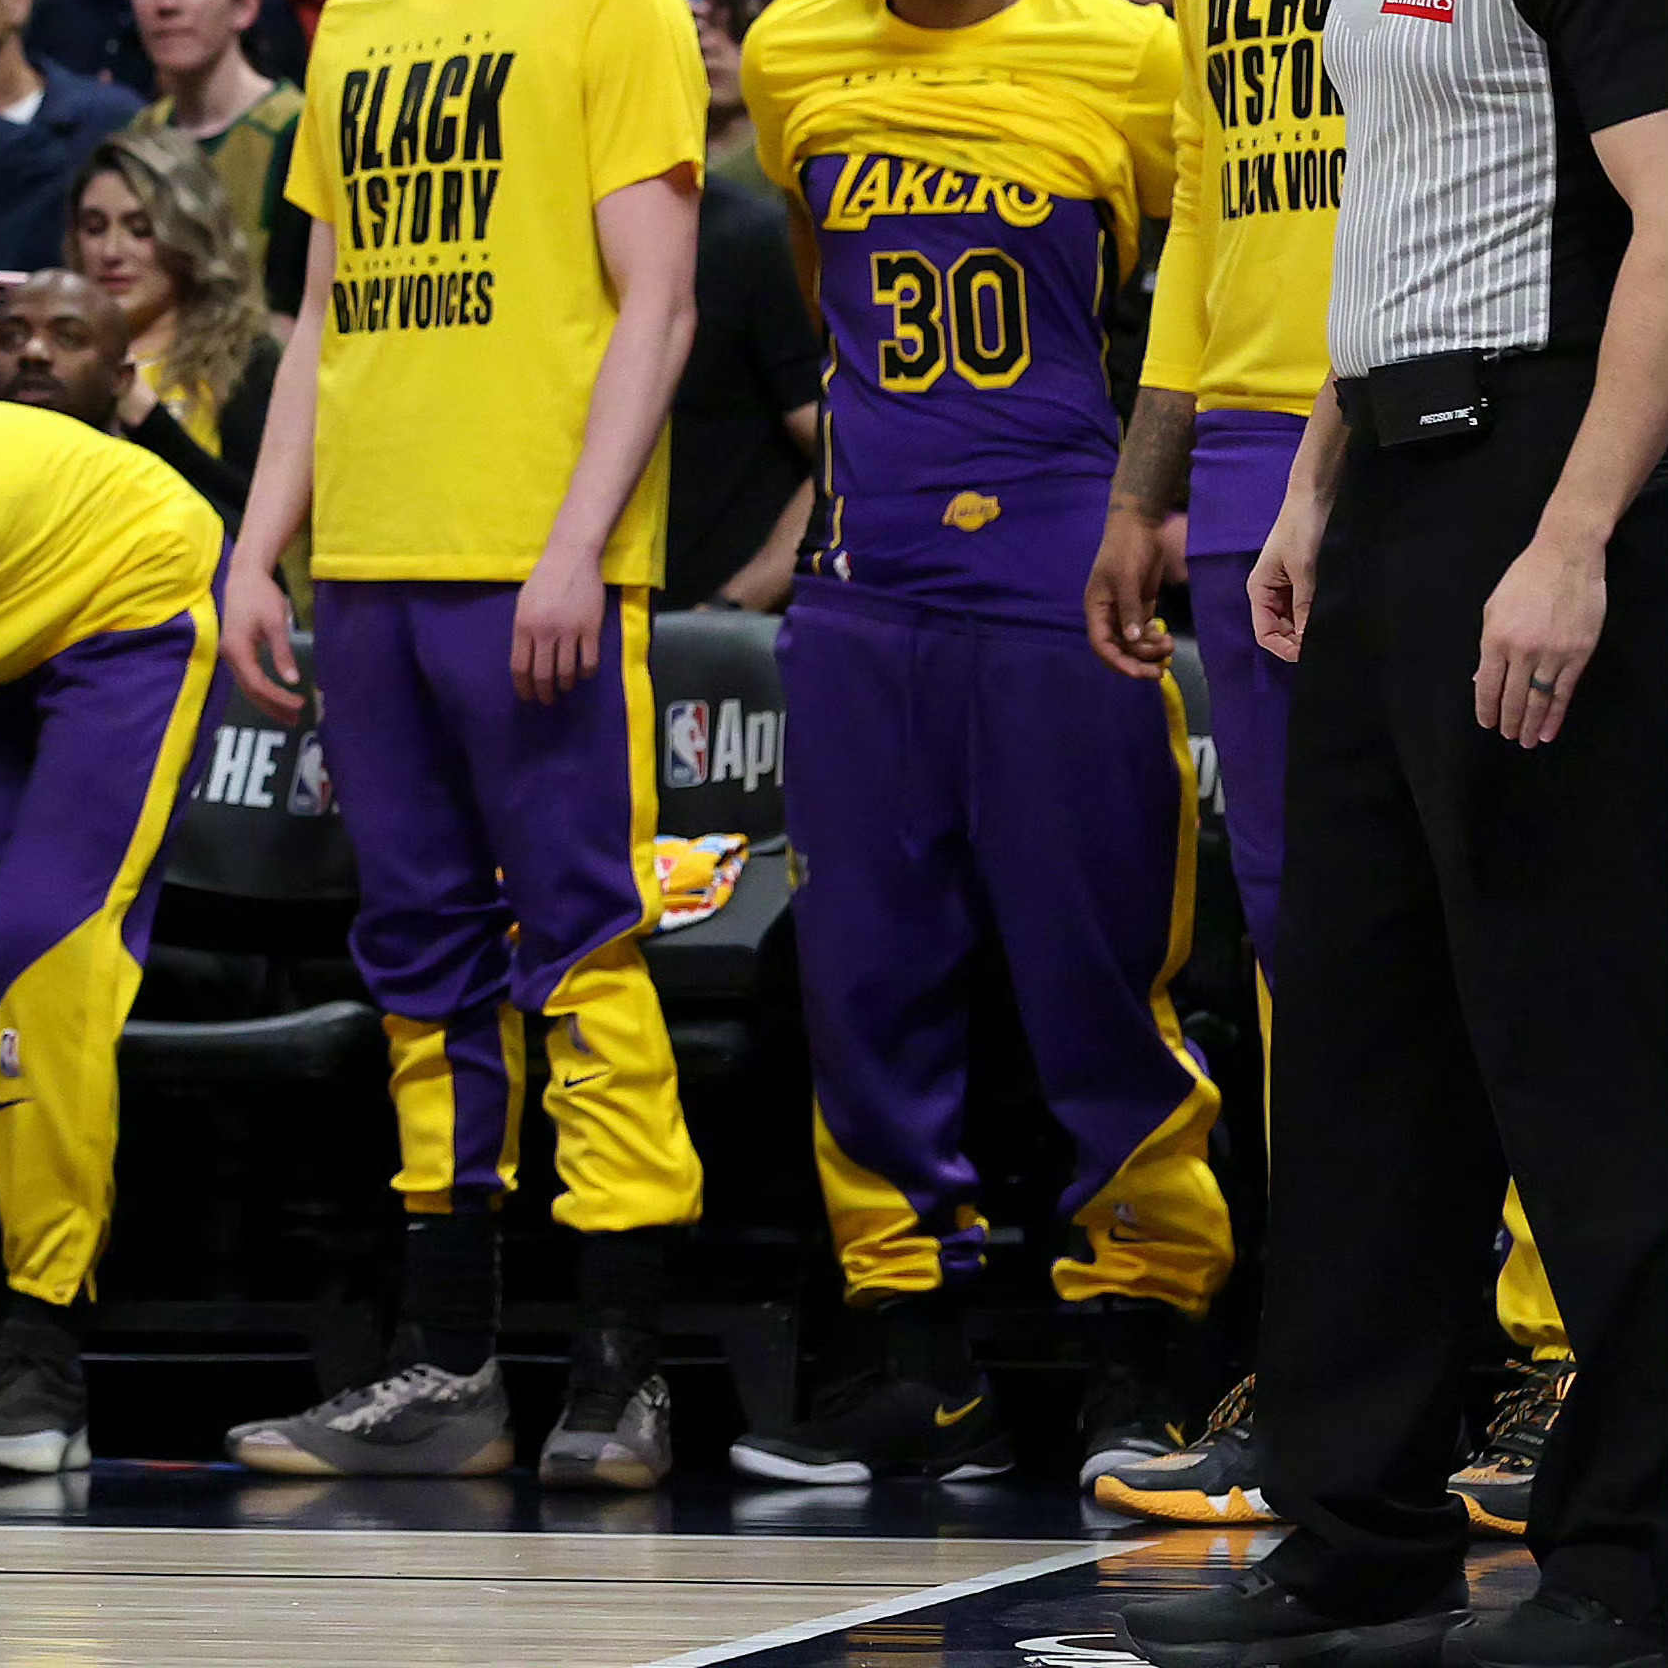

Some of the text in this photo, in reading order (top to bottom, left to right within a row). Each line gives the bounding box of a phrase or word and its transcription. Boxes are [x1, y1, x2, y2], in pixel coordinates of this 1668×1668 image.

[340, 52, 517, 178] BLACK
[821, 154, 1054, 232] LAKERS
[1284, 147, 1347, 213] VOIC
[399, 270, 496, 331] VOICES
[869, 247, 1032, 394] 30
[191, 725, 287, 809] HE
